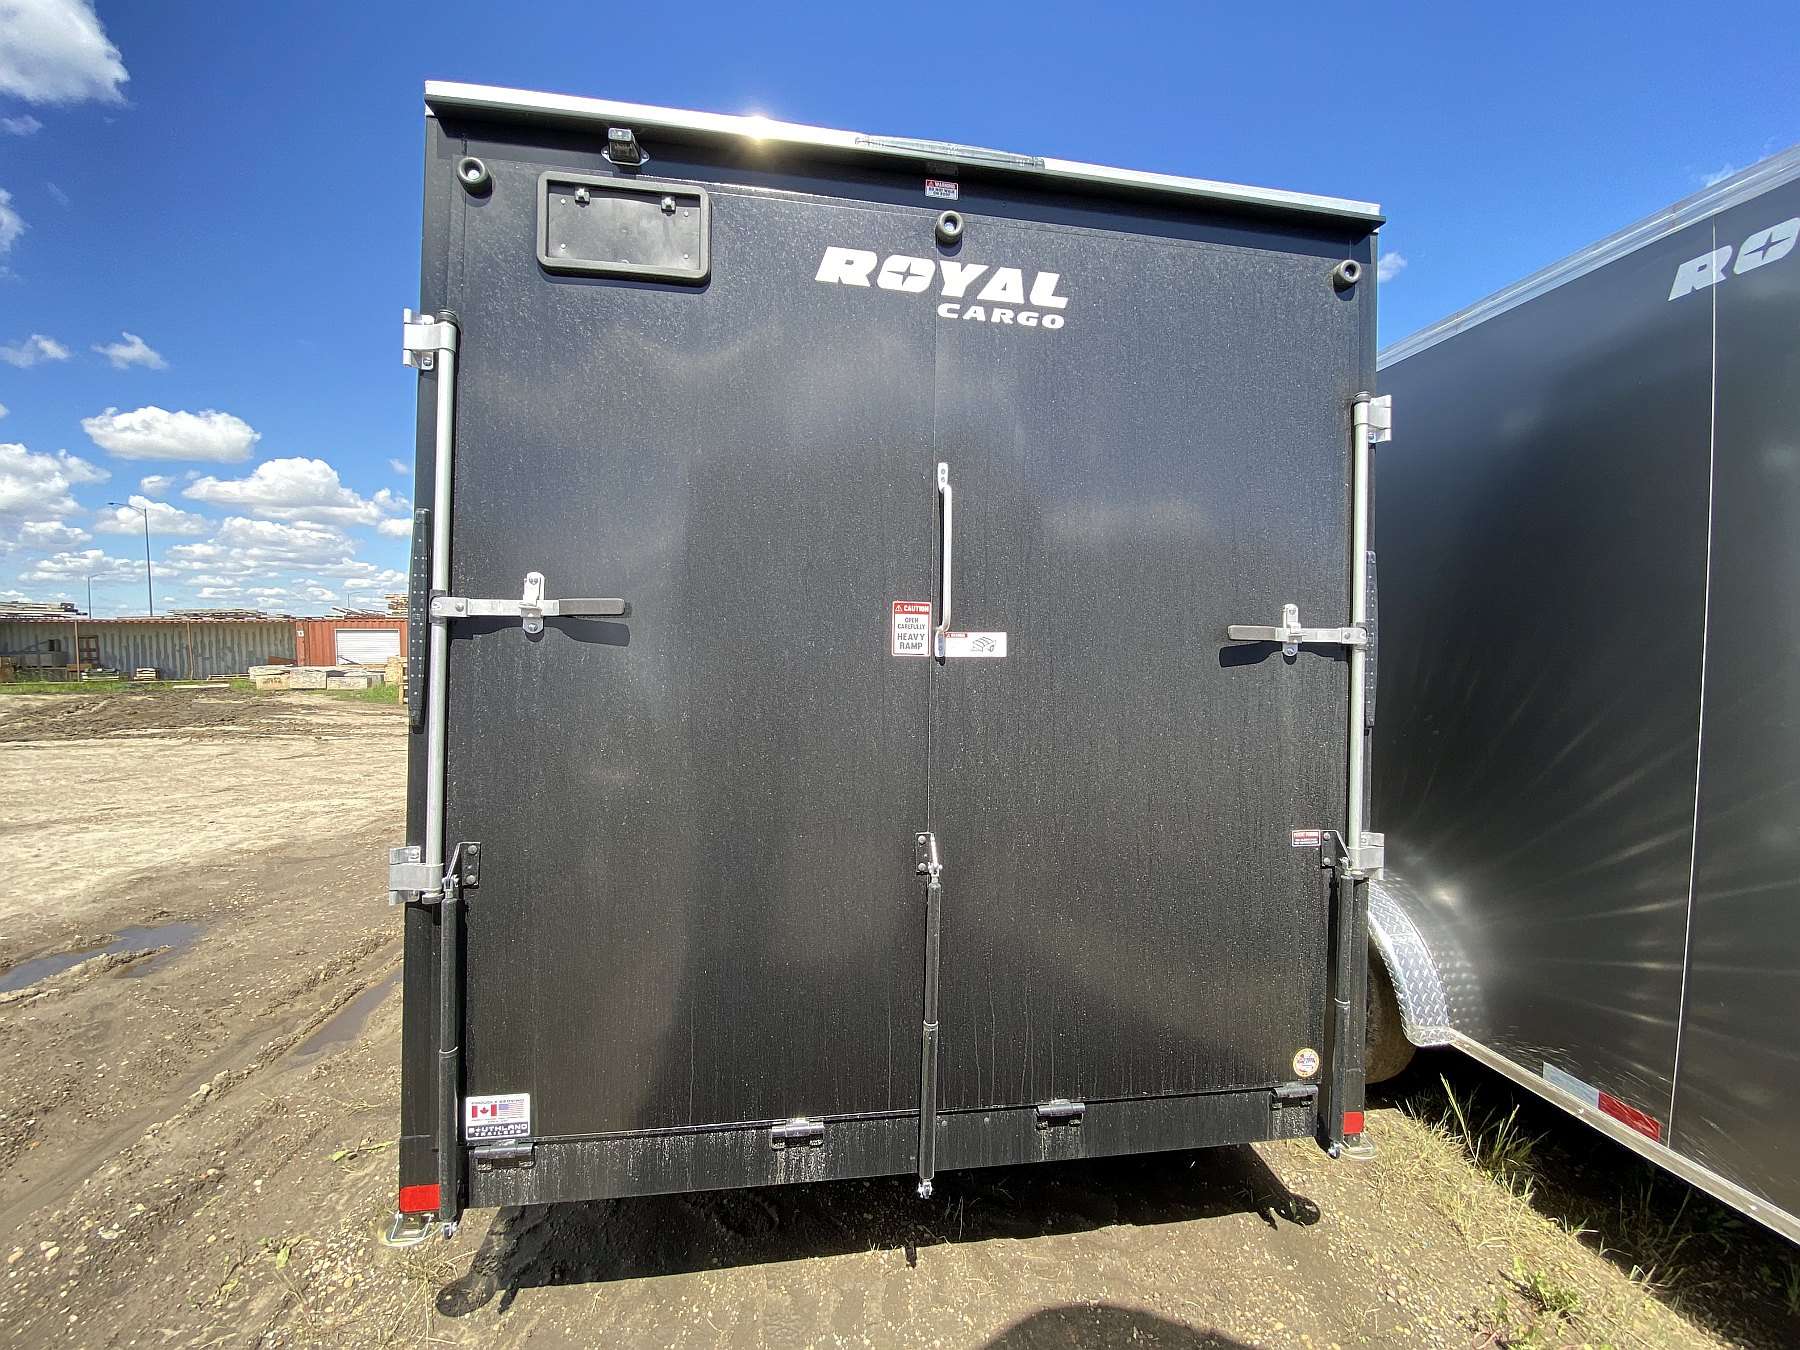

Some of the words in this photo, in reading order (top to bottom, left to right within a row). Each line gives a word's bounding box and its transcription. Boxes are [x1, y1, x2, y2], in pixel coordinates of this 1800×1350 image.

[815, 246, 1069, 309] ROYAL
[937, 302, 1065, 329] CARGO
[903, 604, 929, 613] CAUTION
[897, 632, 926, 641] HEAVY
[899, 641, 923, 650] RAMP
